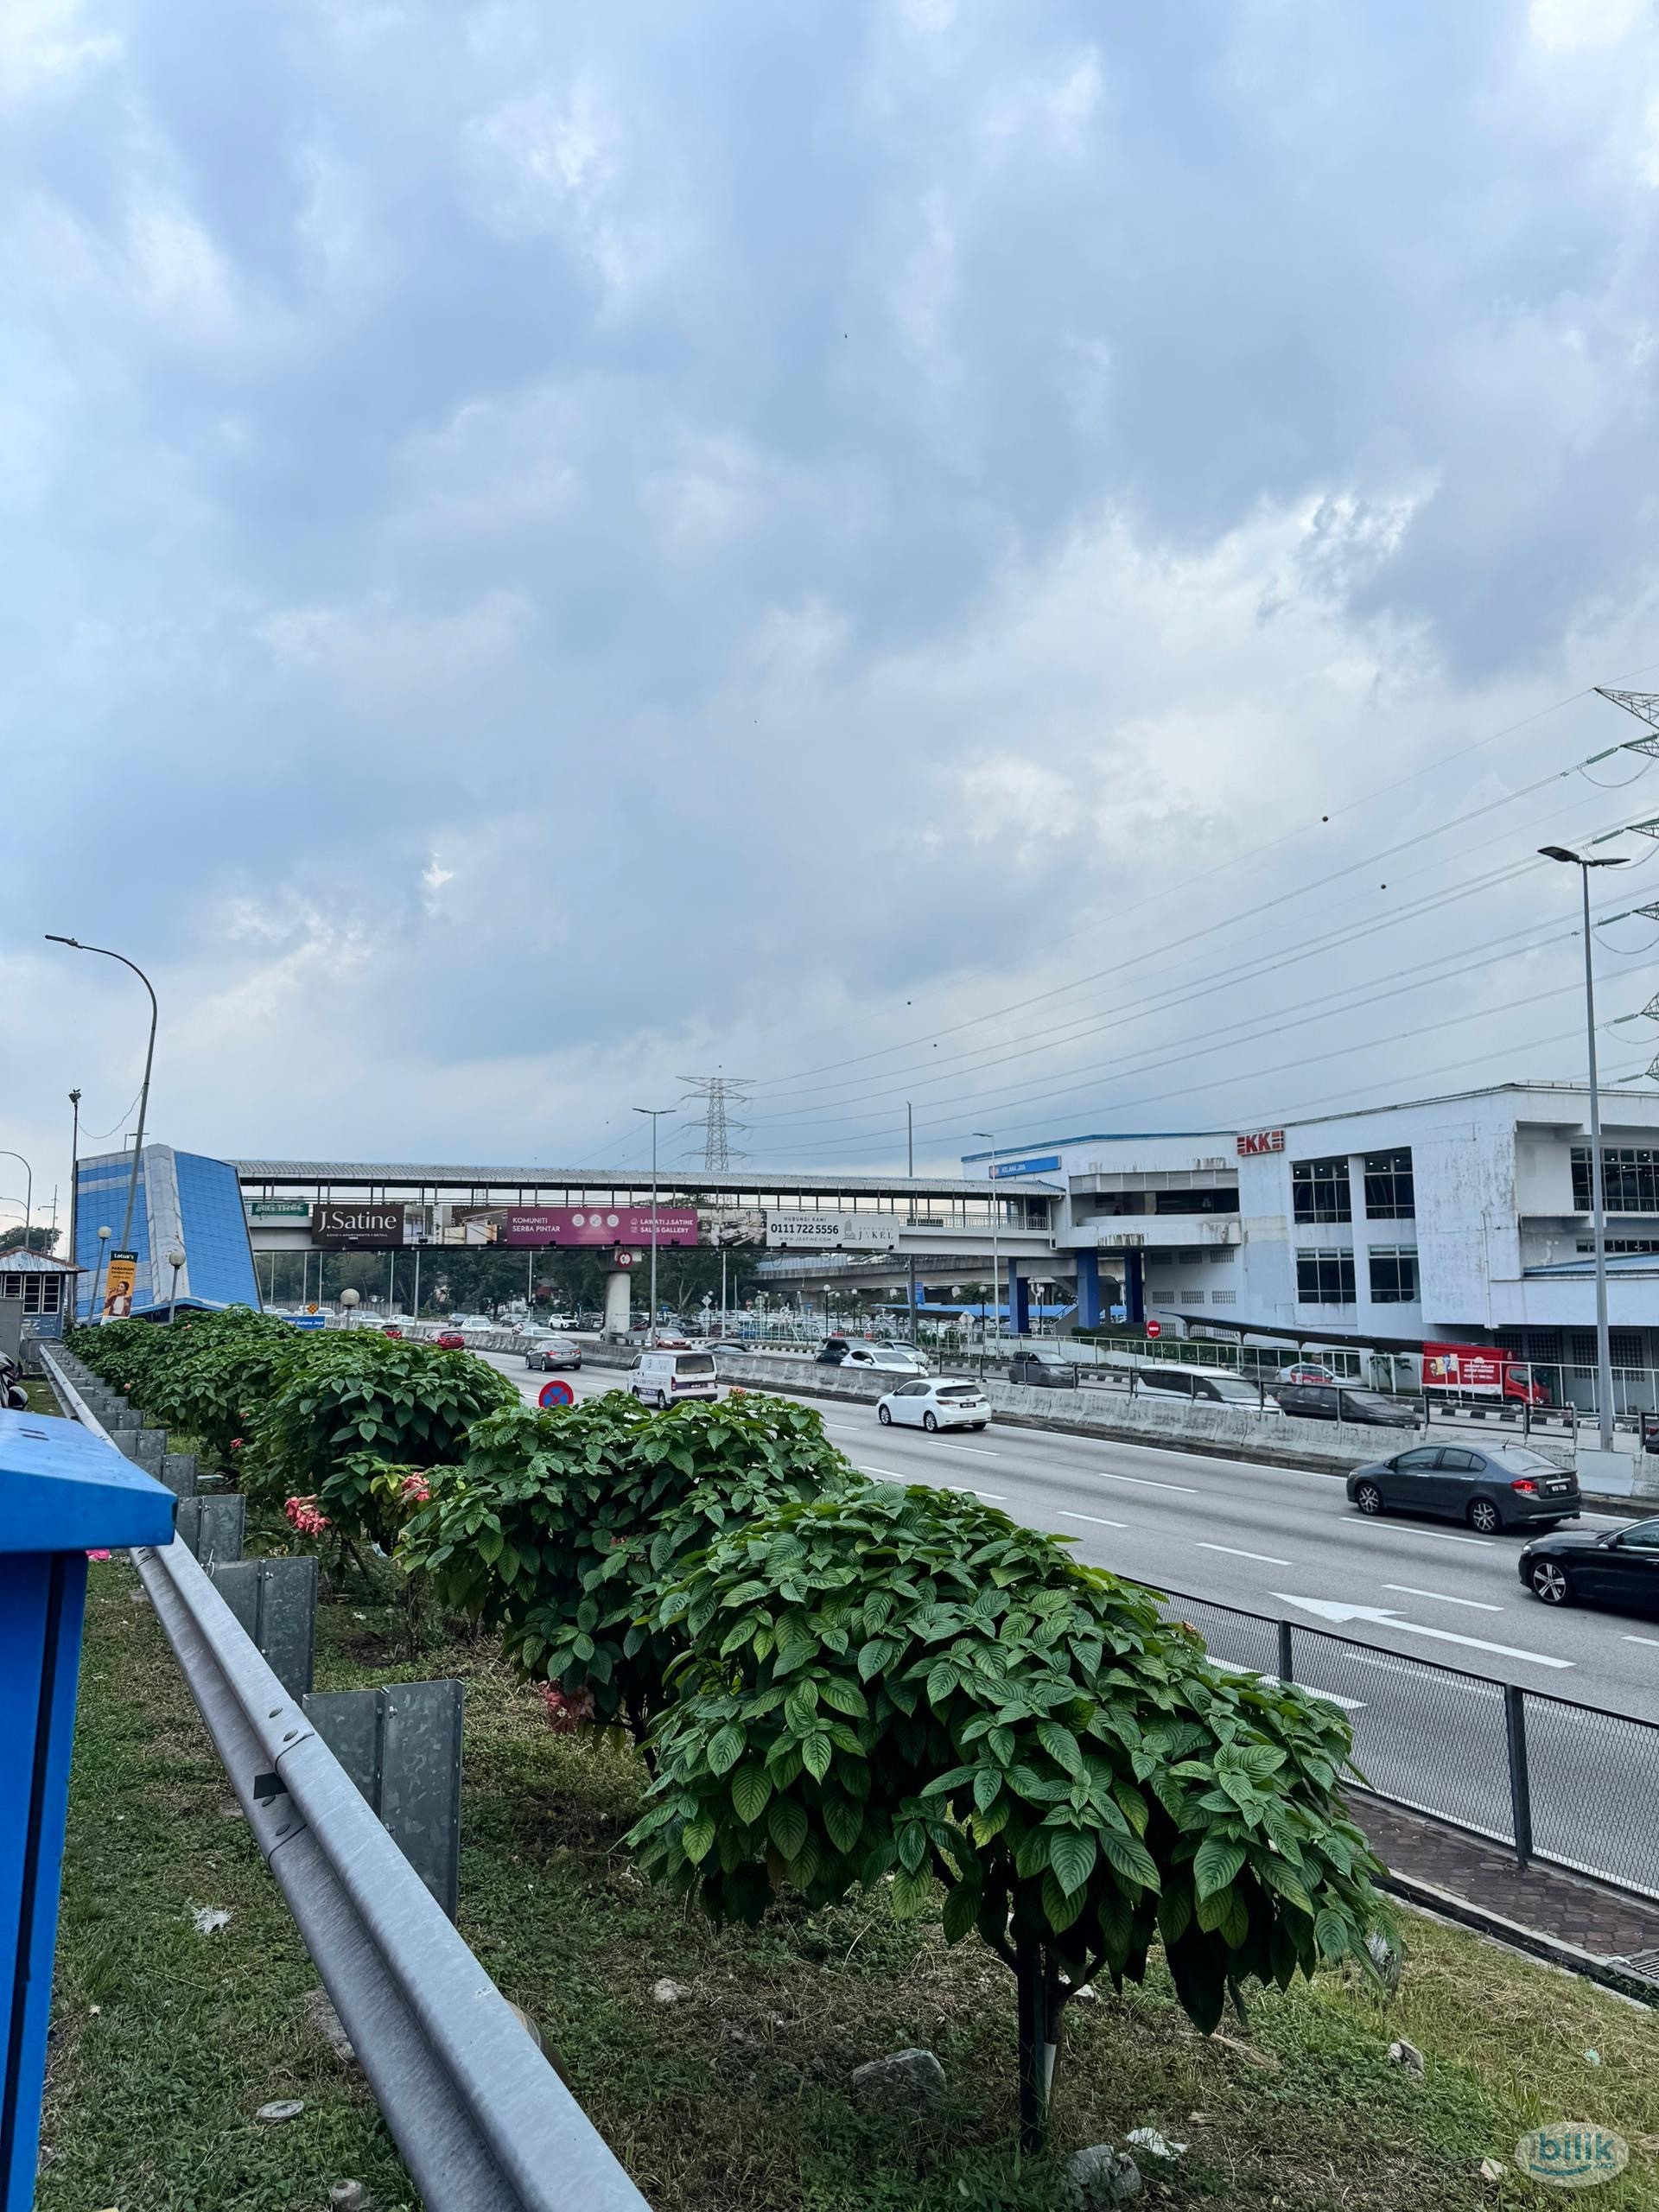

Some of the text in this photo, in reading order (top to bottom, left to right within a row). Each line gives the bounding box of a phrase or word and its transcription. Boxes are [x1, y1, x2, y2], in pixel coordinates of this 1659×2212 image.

[318, 1211, 397, 1232] J.Satine
[771, 1224, 839, 1234] 0111 722 5556
